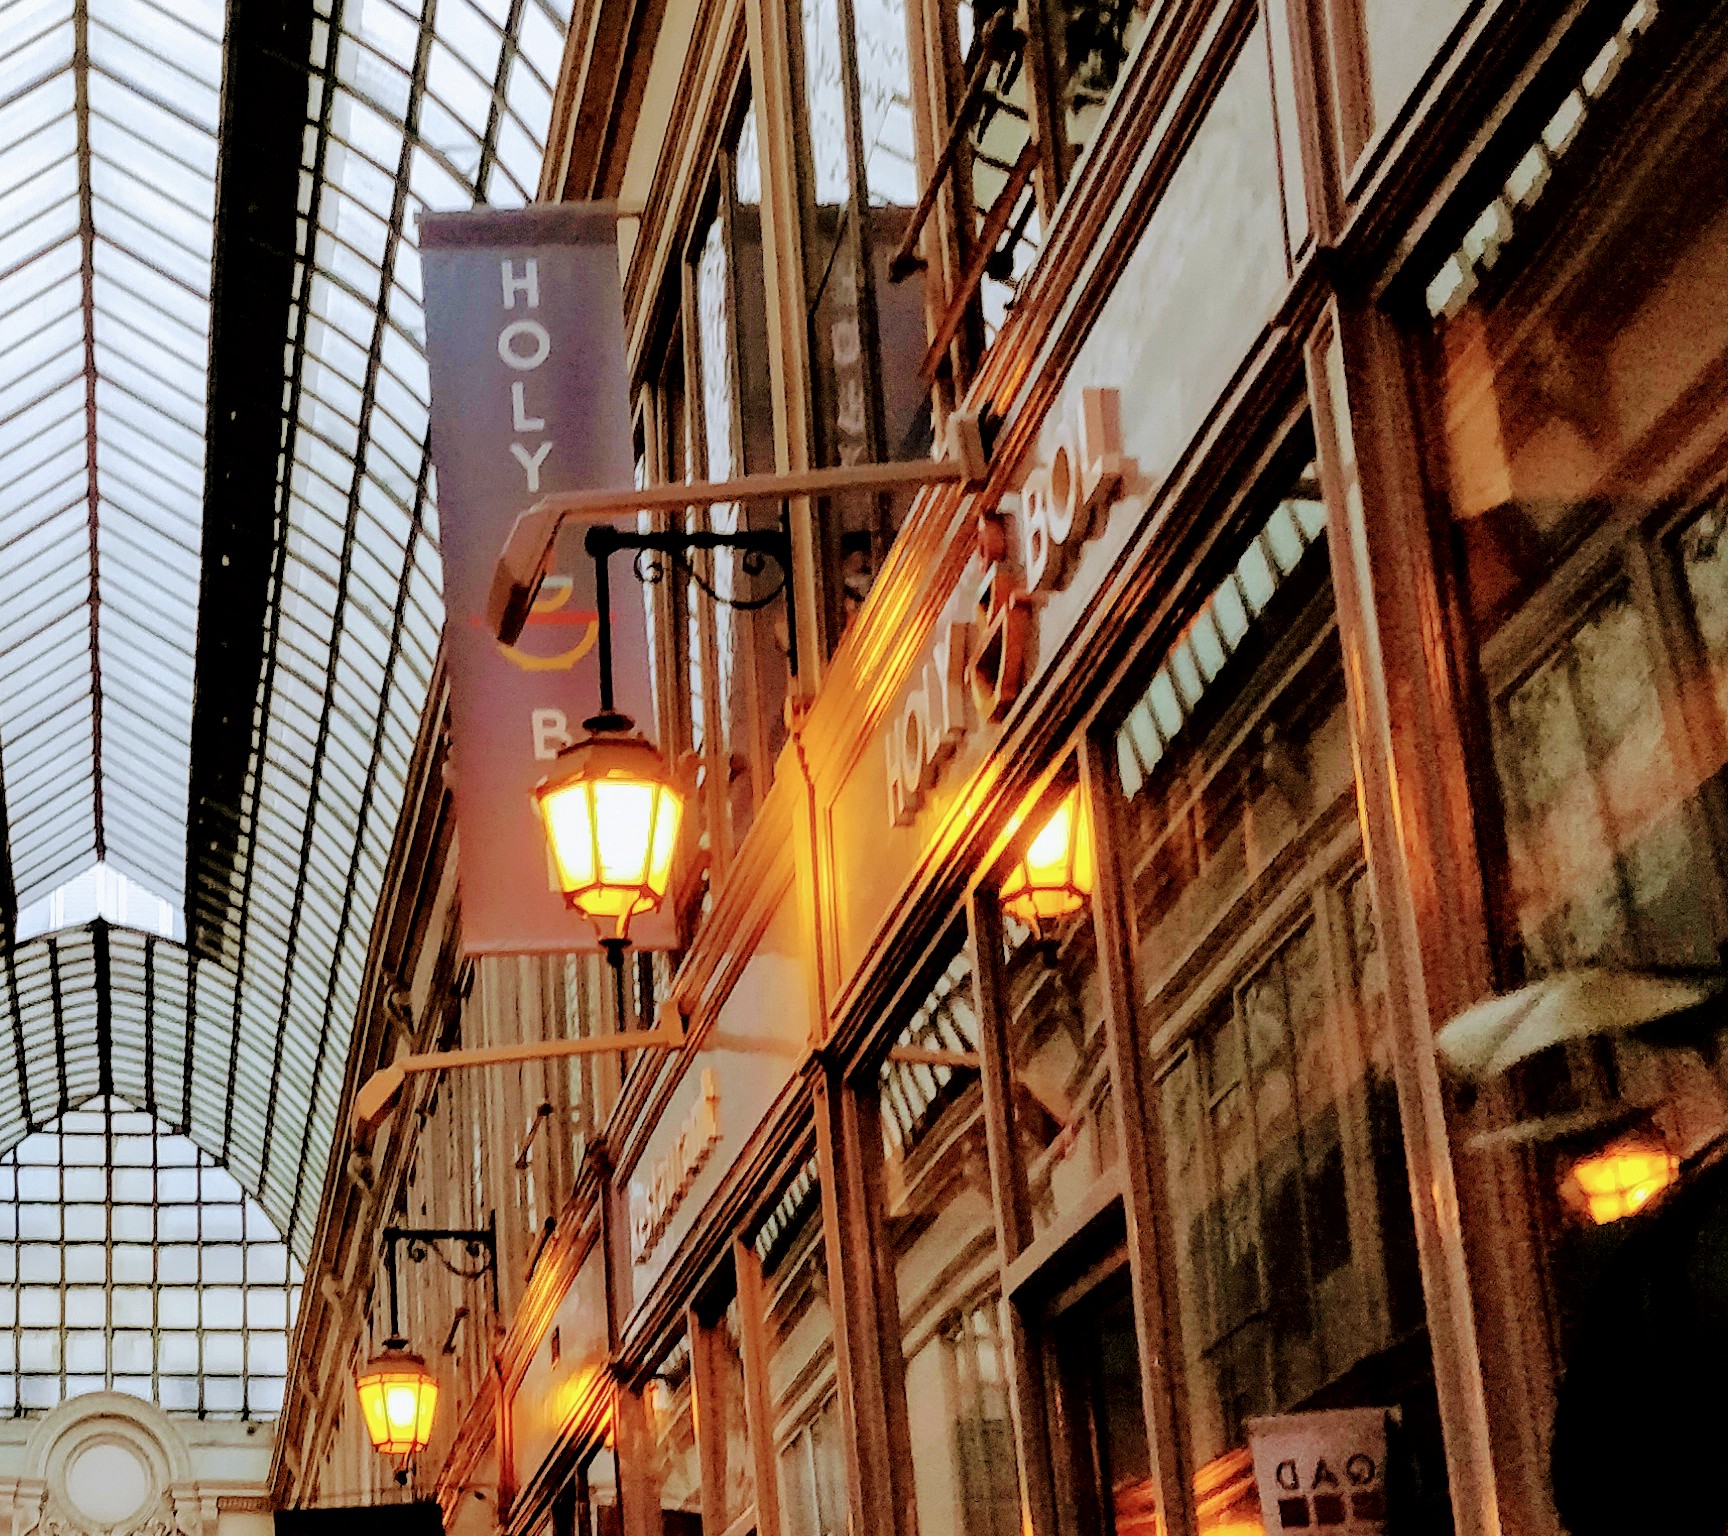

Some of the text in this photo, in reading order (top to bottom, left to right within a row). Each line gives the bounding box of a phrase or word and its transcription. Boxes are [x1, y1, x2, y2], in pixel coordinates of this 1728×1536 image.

[496, 257, 555, 495] HOLY
[885, 386, 1112, 826] HOLY BOL
